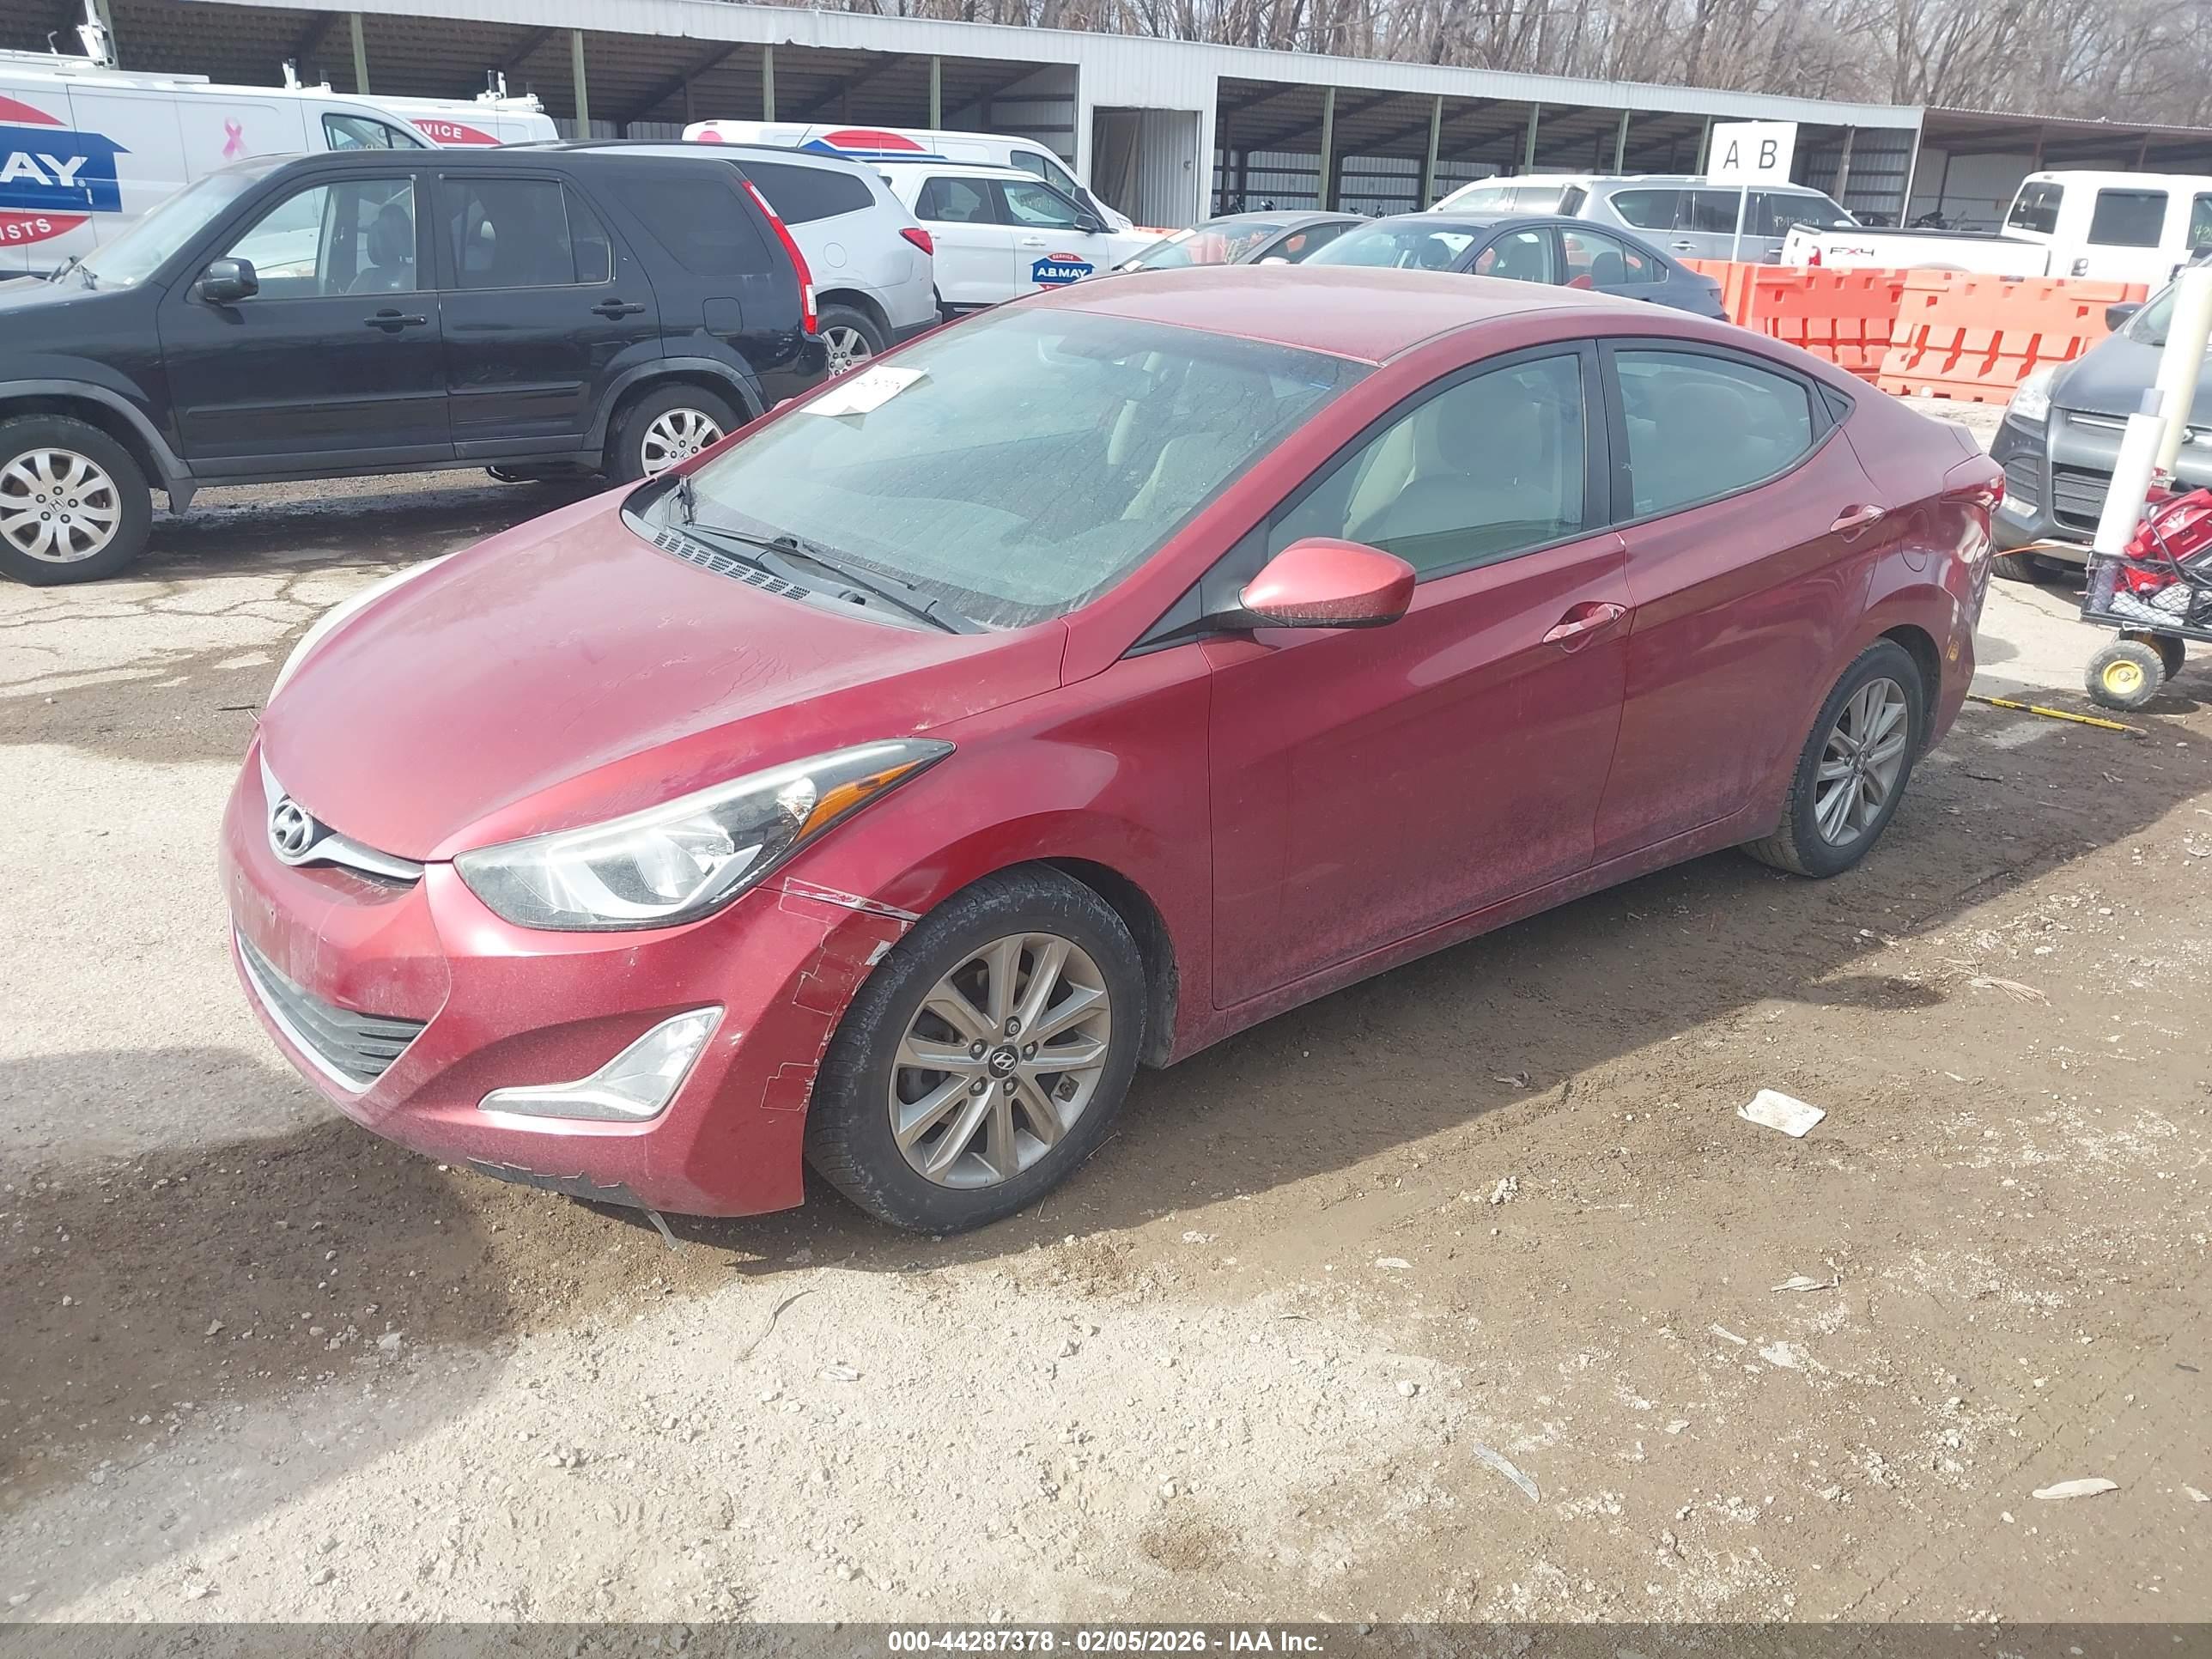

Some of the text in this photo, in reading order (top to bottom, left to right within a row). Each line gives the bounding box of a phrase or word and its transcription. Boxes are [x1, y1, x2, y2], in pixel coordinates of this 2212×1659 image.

[1723, 140, 1778, 169] A B
[1830, 247, 1875, 257] FX4
